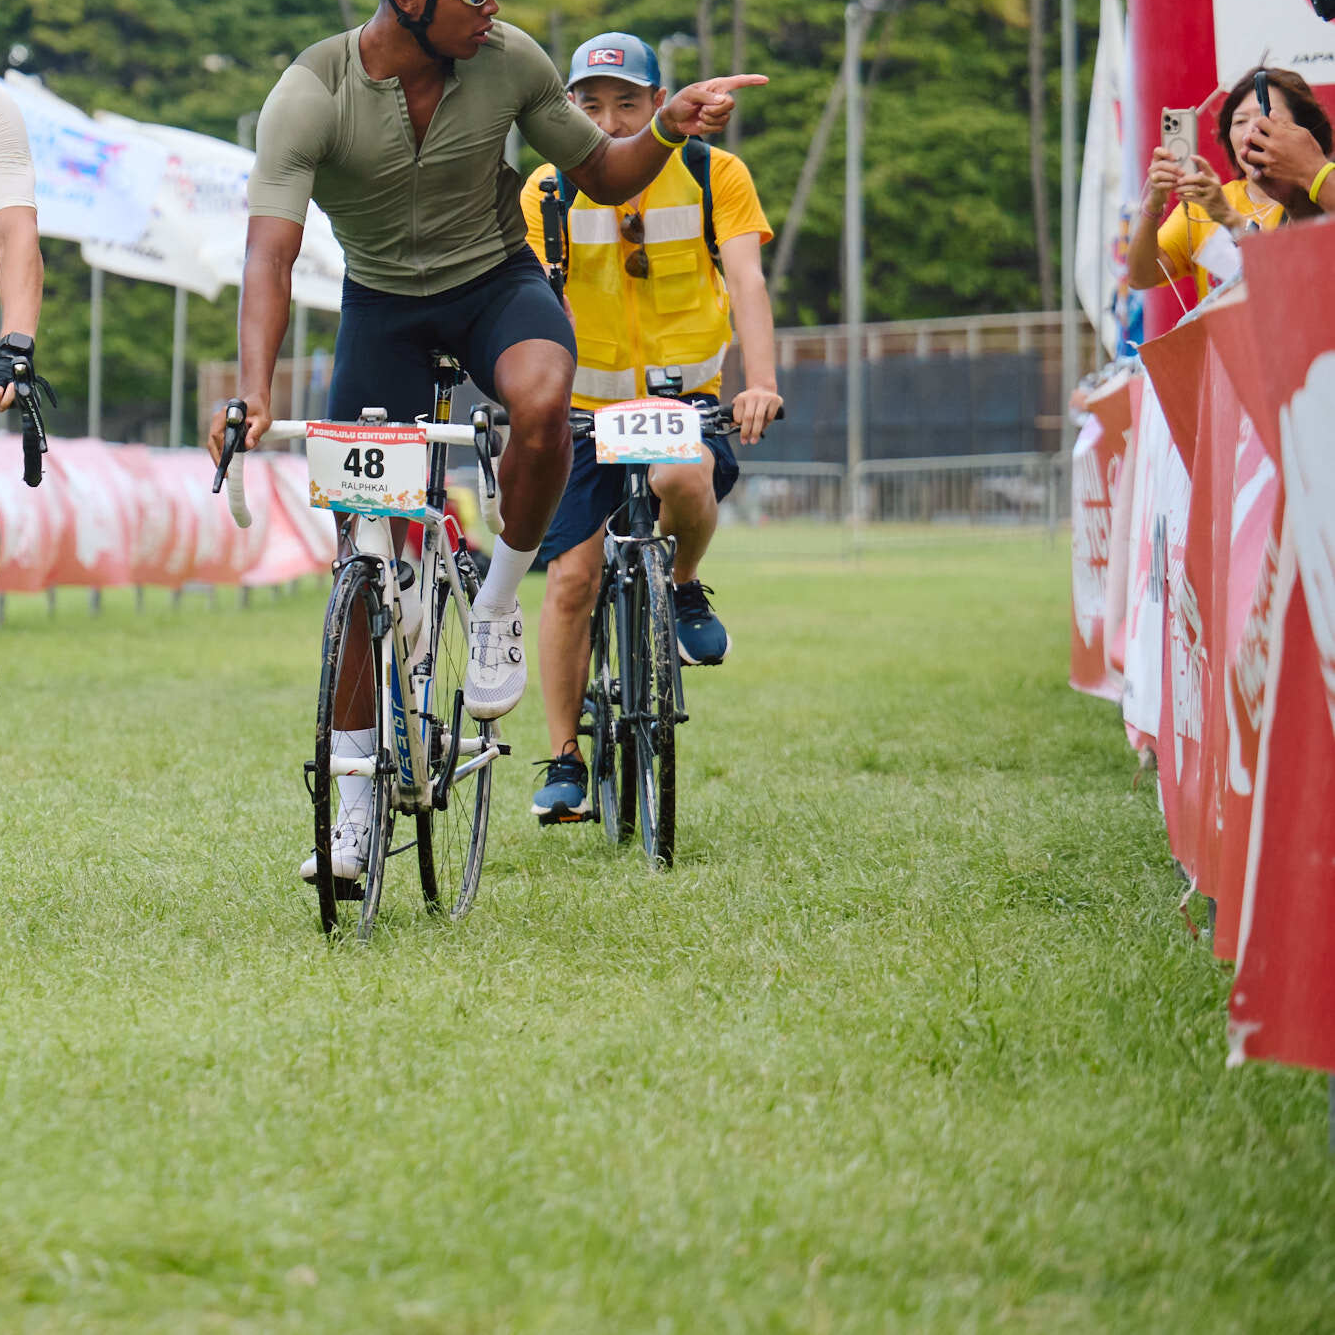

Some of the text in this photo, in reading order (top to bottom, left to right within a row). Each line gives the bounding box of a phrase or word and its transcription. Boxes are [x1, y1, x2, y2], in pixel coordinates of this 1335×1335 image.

[612, 412, 685, 435] 1215
[313, 428, 356, 439] HONOLULU
[357, 432, 396, 441] CENTURY
[343, 447, 385, 479] 48
[341, 481, 389, 493] RALPHKAI
